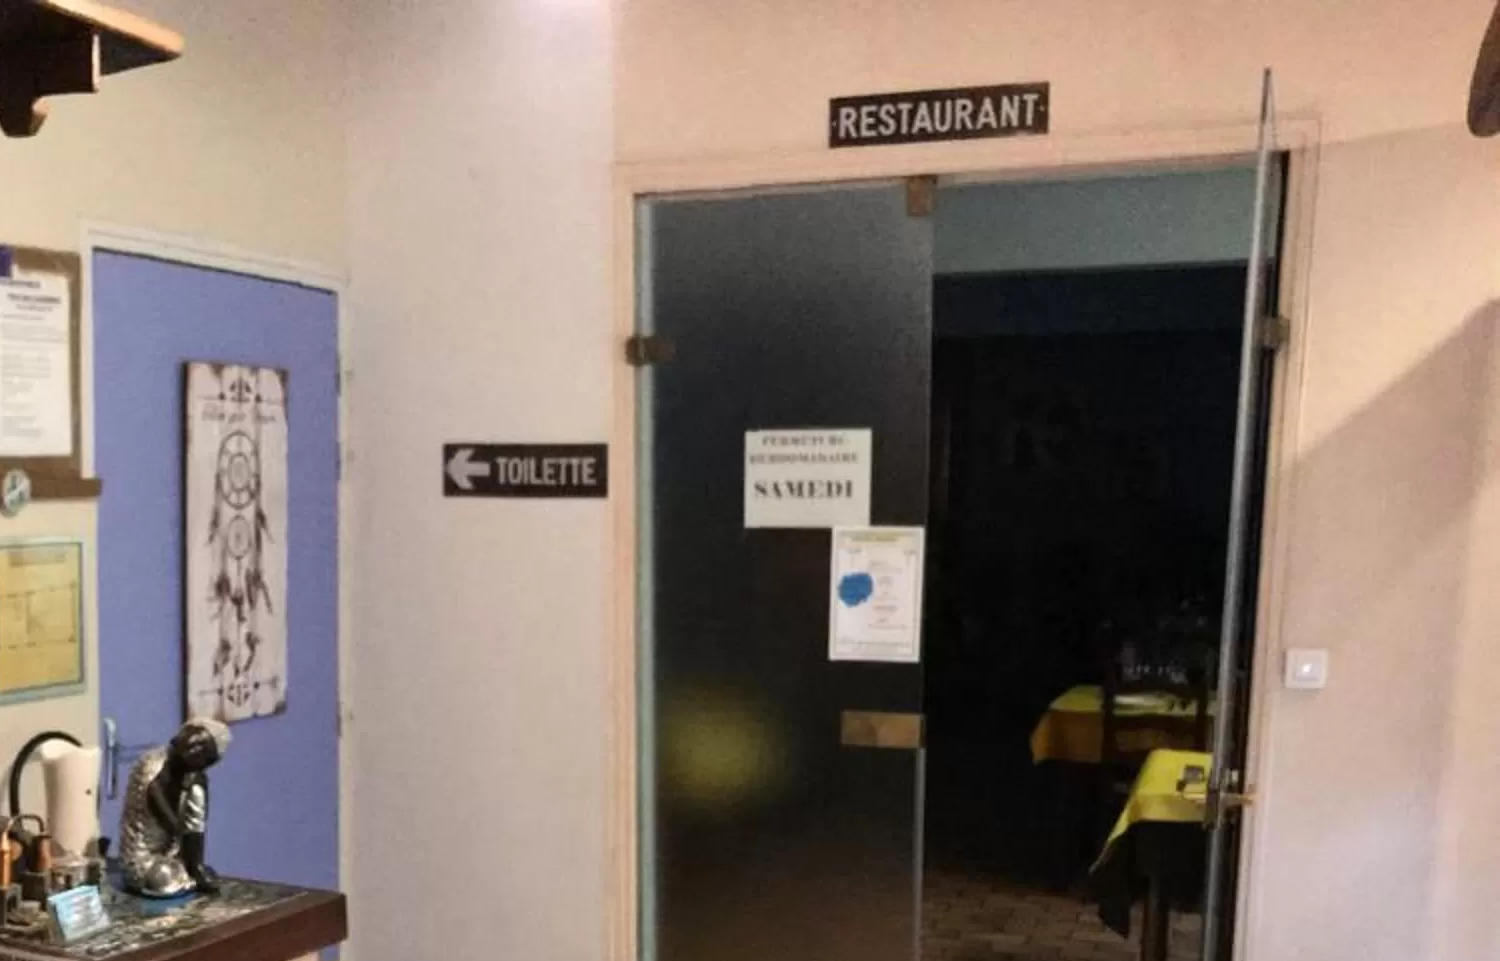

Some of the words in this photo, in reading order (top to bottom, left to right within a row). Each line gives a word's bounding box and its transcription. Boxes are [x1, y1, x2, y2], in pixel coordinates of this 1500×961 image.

[838, 93, 1040, 139] RESTAURANT
[496, 456, 597, 486] TOILETTE
[753, 479, 853, 499] SAMEDI
